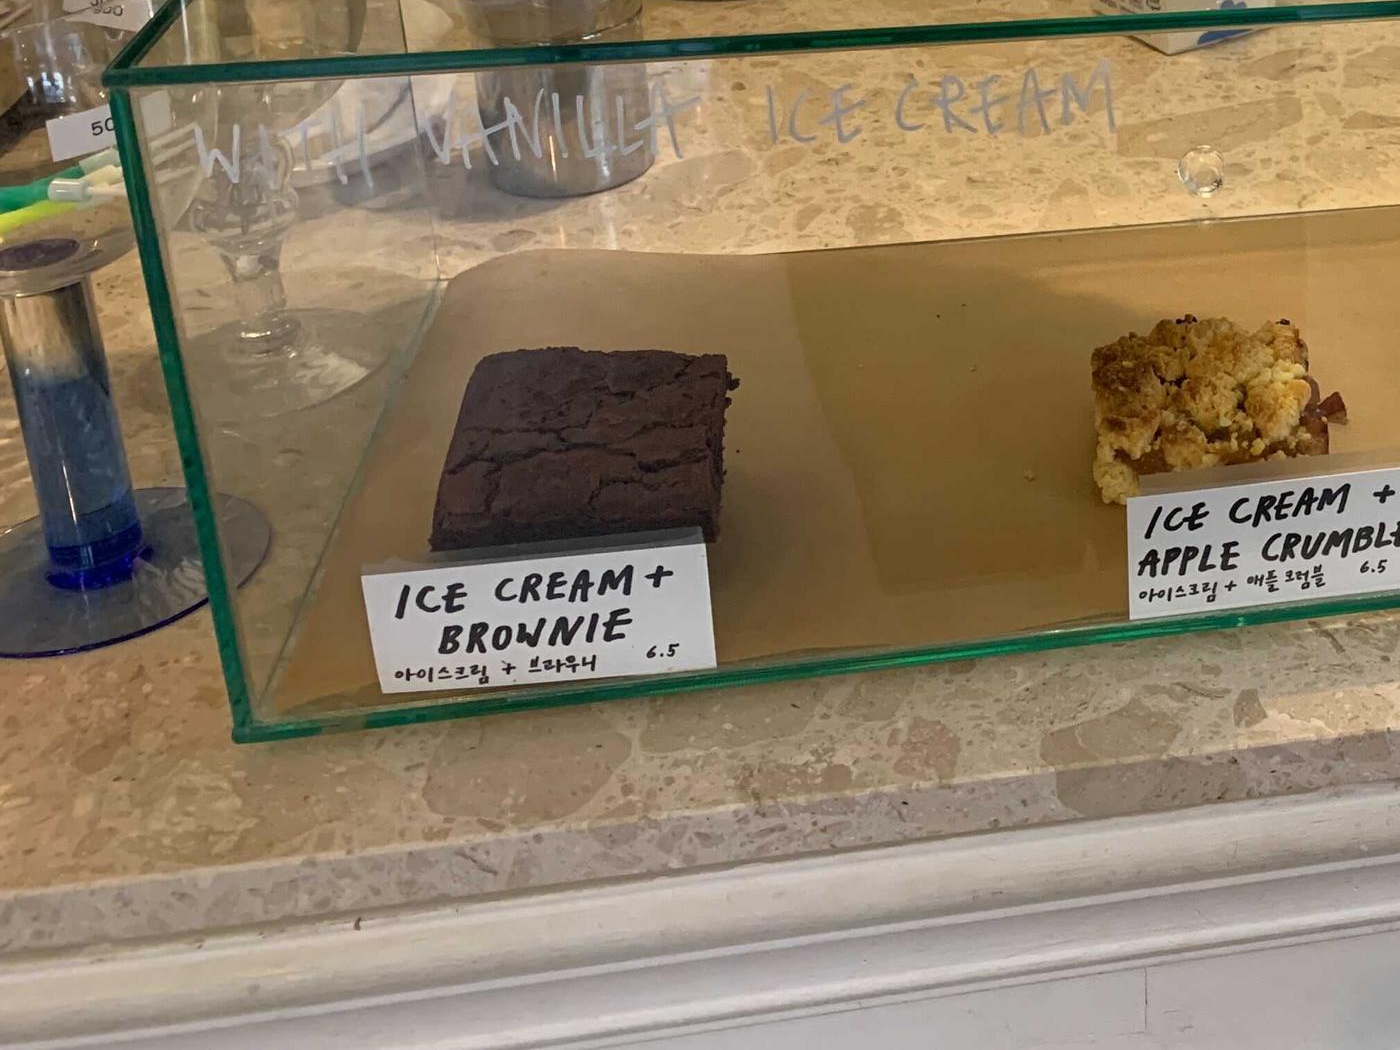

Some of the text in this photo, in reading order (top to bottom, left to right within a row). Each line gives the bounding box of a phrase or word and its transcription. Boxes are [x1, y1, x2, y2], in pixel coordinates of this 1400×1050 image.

[424, 79, 701, 170] VANILLA
[765, 83, 865, 147] ICE
[895, 58, 1118, 136] CREAM
[1143, 501, 1210, 540] ICE
[1228, 482, 1352, 528] CREAM
[1136, 540, 1240, 578] APPLE
[1359, 558, 1389, 575] 6.5
[394, 583, 469, 620] ICE
[494, 563, 635, 604] CREAM
[1138, 580, 1218, 603] 아이스크림
[1246, 568, 1280, 593] 애플
[437, 606, 634, 655] BROWNIE
[394, 663, 490, 685] 아이스크림
[527, 653, 598, 674] 브라우니
[645, 642, 681, 660] 6.5
